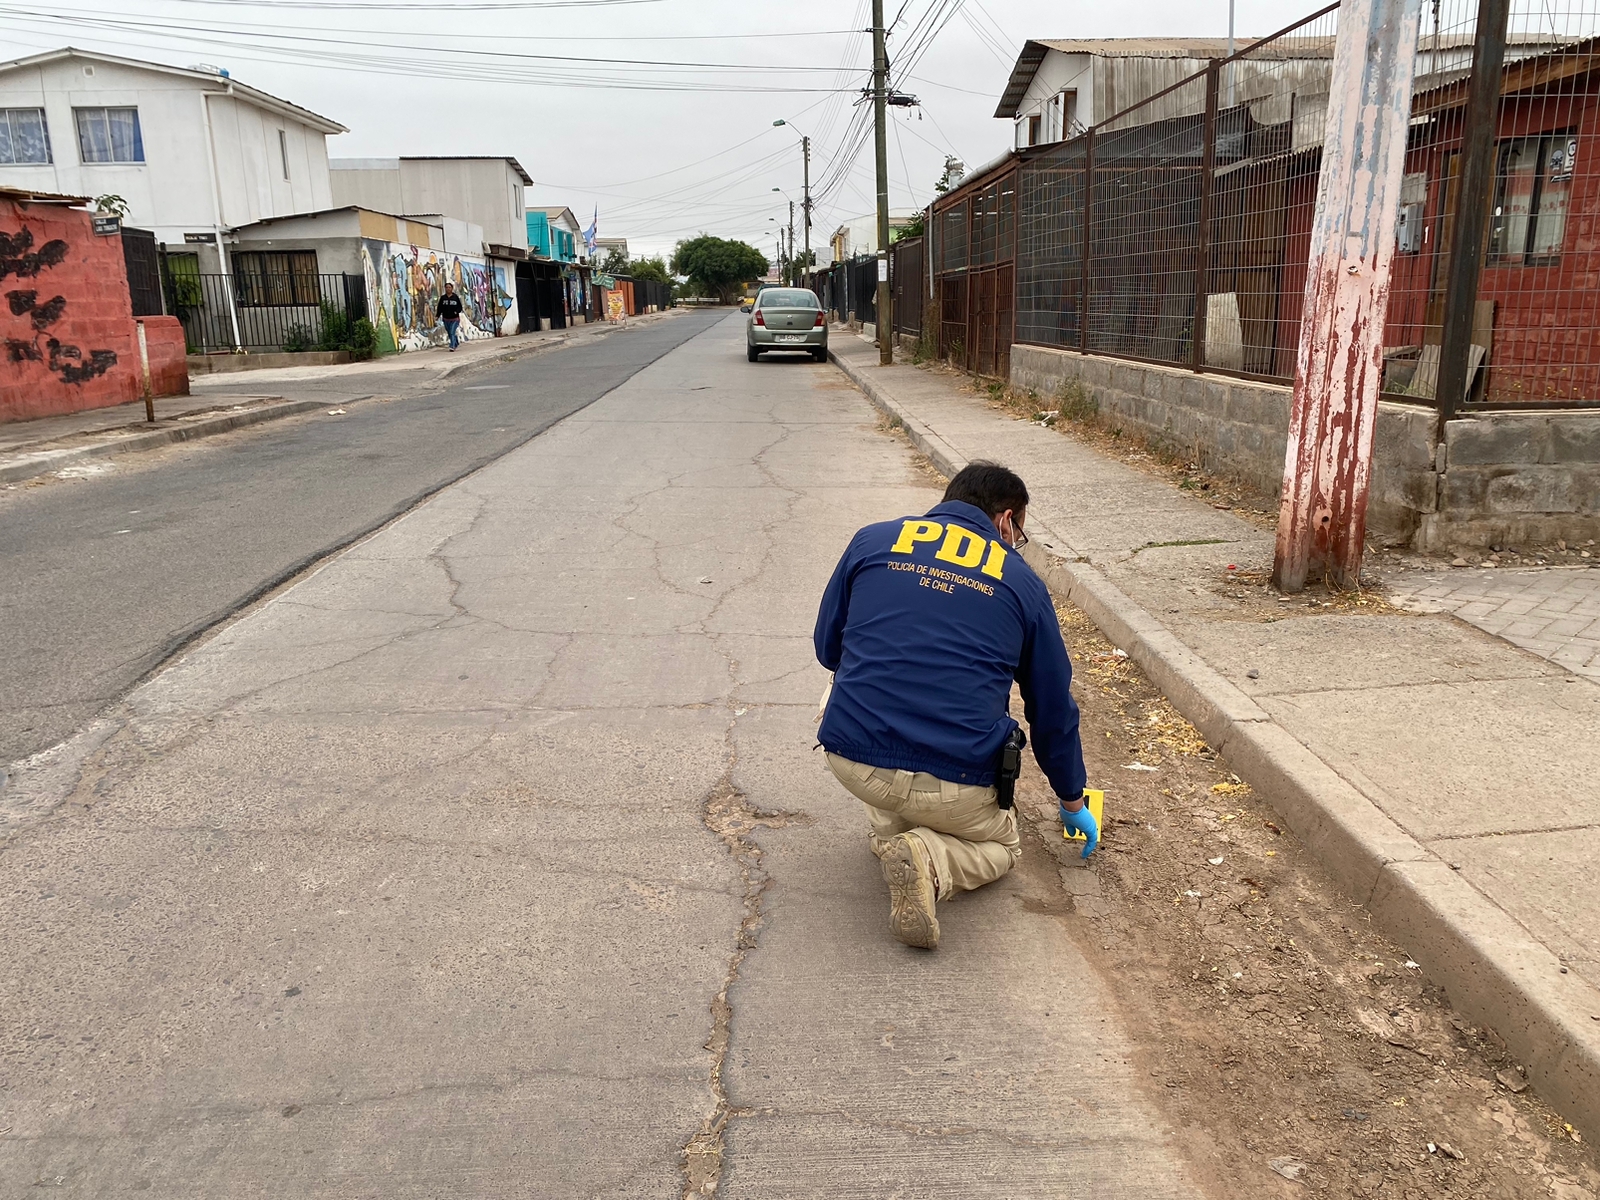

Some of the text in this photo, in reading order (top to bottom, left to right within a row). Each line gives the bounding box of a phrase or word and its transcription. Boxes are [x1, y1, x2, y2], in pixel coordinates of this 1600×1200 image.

[890, 520, 1008, 580] PDI
[887, 561, 995, 596] POLICÍA DE INVESTIGACIONES
[919, 576, 955, 594] DE CHILE
